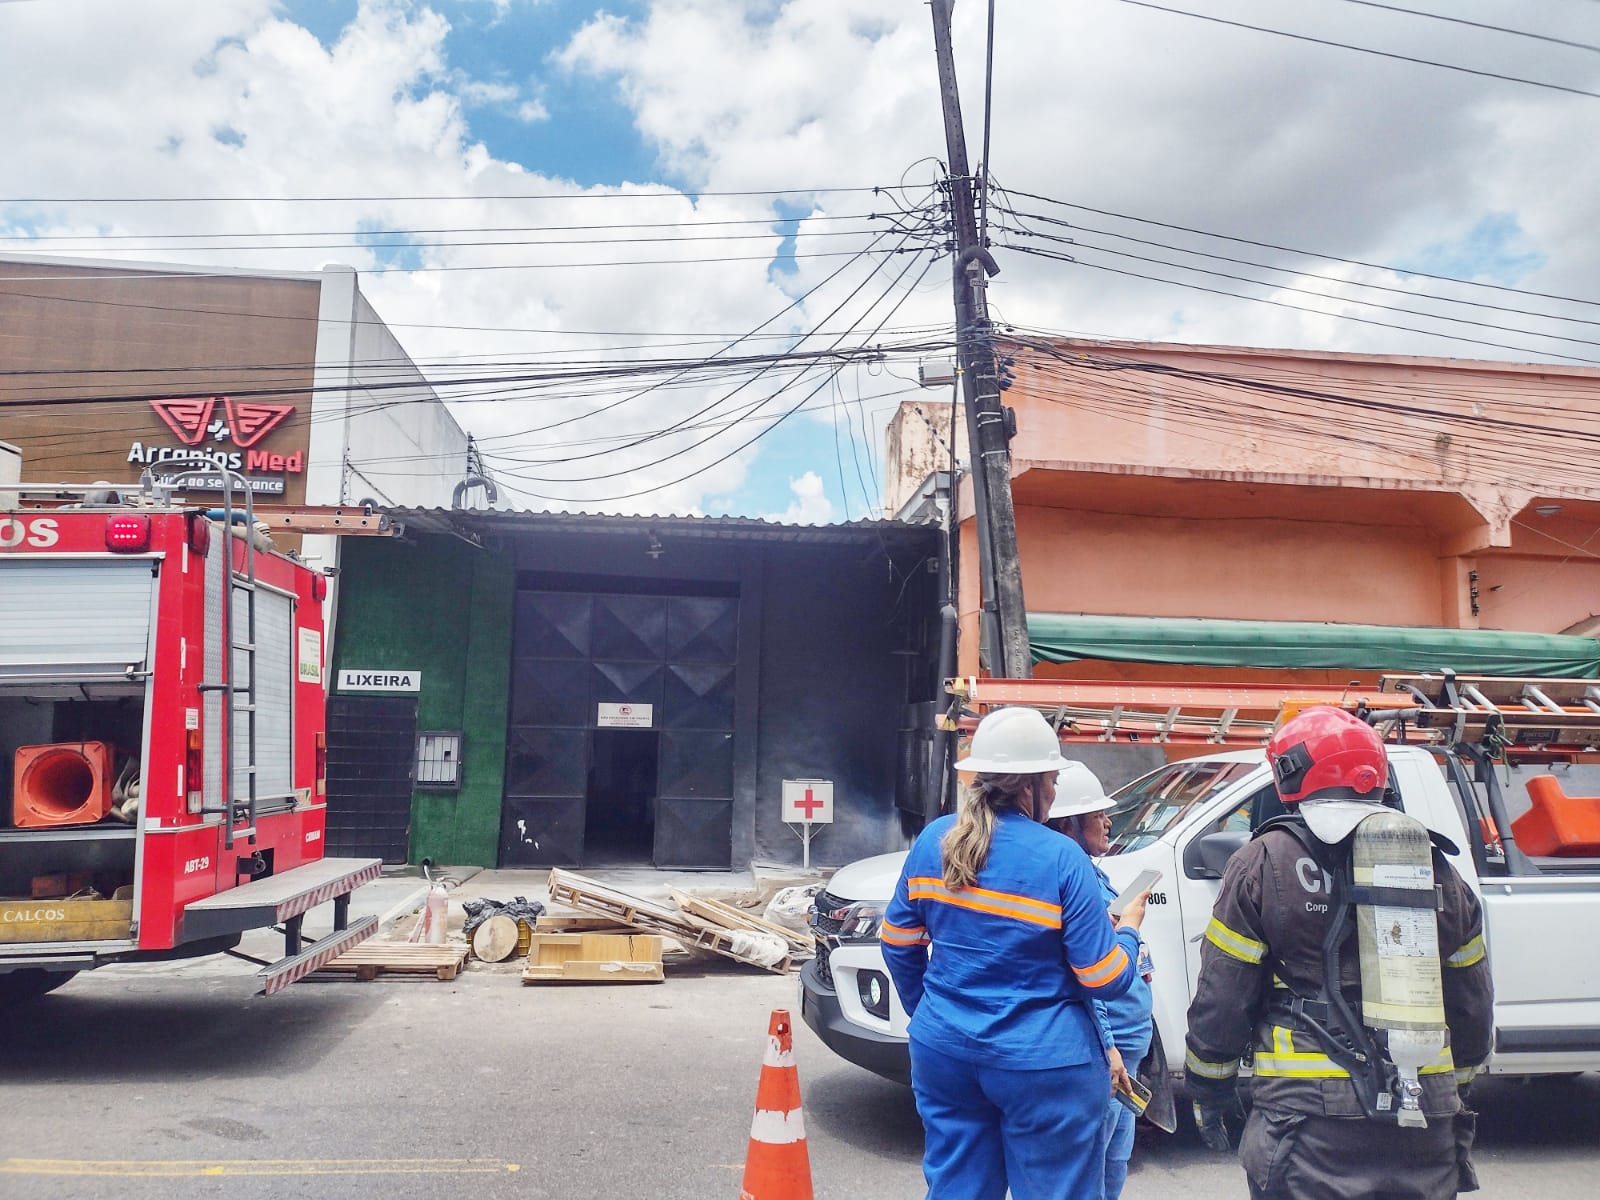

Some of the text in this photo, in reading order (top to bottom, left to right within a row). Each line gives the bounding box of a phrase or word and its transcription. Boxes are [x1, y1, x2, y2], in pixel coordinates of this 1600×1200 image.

[127, 441, 304, 474] Arcanjos Med
[187, 478, 204, 487] ao
[207, 478, 226, 488] se
[233, 479, 283, 491] acance
[346, 674, 412, 687] LIXEIRA
[184, 856, 210, 875] ABT-29
[1148, 892, 1167, 905] 806
[1305, 901, 1328, 914] Corp
[3, 908, 65, 925] CALÇOS
